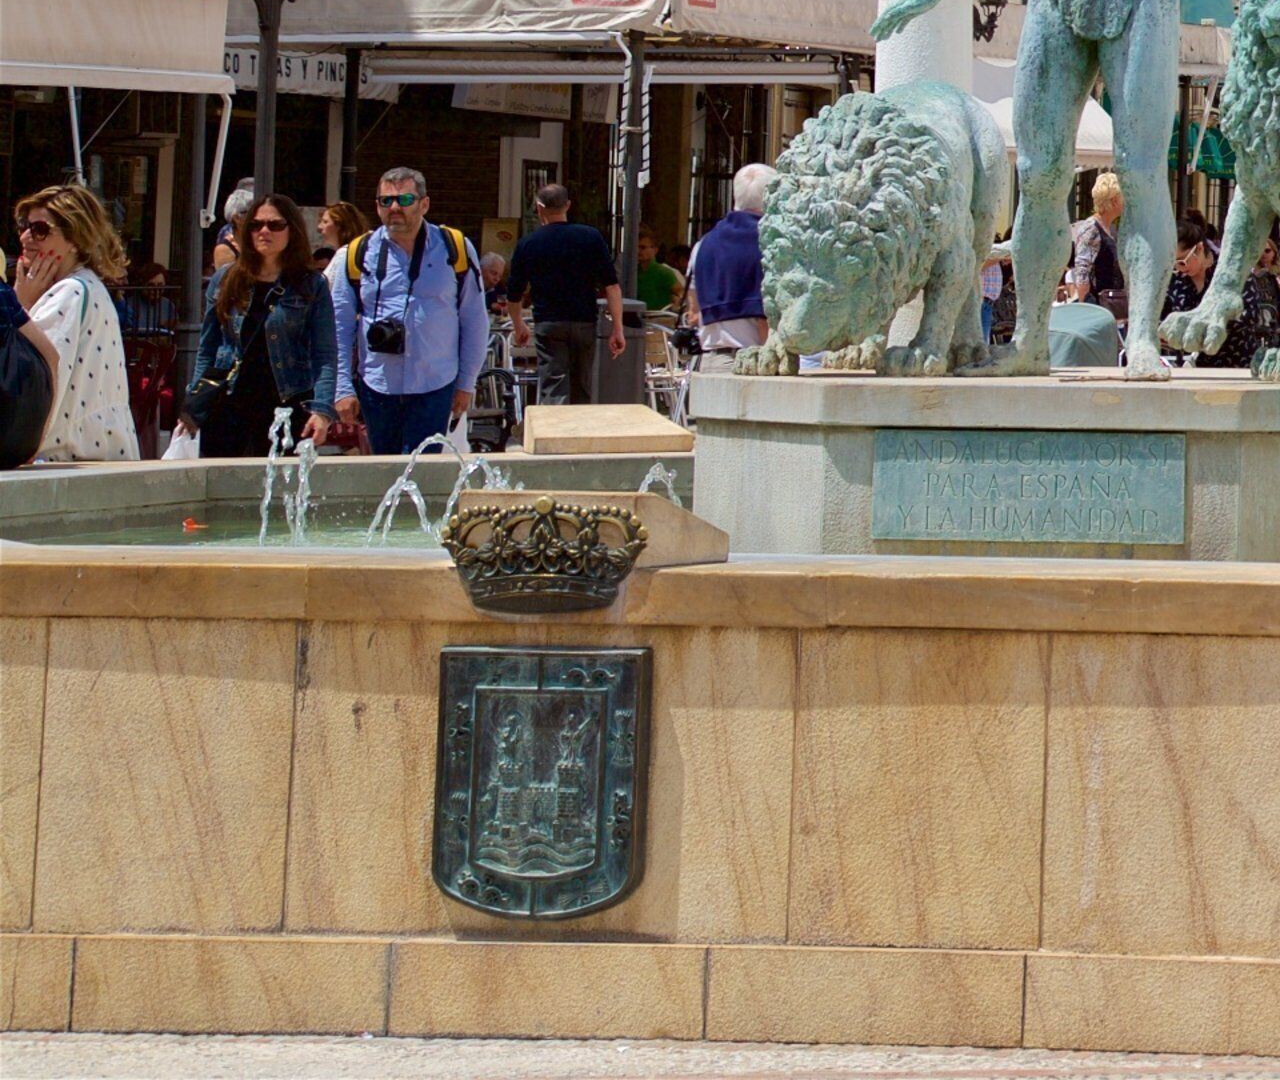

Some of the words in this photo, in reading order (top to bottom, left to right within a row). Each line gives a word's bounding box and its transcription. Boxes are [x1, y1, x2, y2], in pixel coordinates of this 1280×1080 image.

[302, 59, 309, 81] Y
[1080, 440, 1136, 468] POR
[925, 471, 1003, 500] PARA
[1019, 470, 1133, 501] ESPAÑA
[898, 505, 914, 531] Y
[924, 505, 955, 533] LA
[968, 505, 1160, 536] HUMANIDAD
